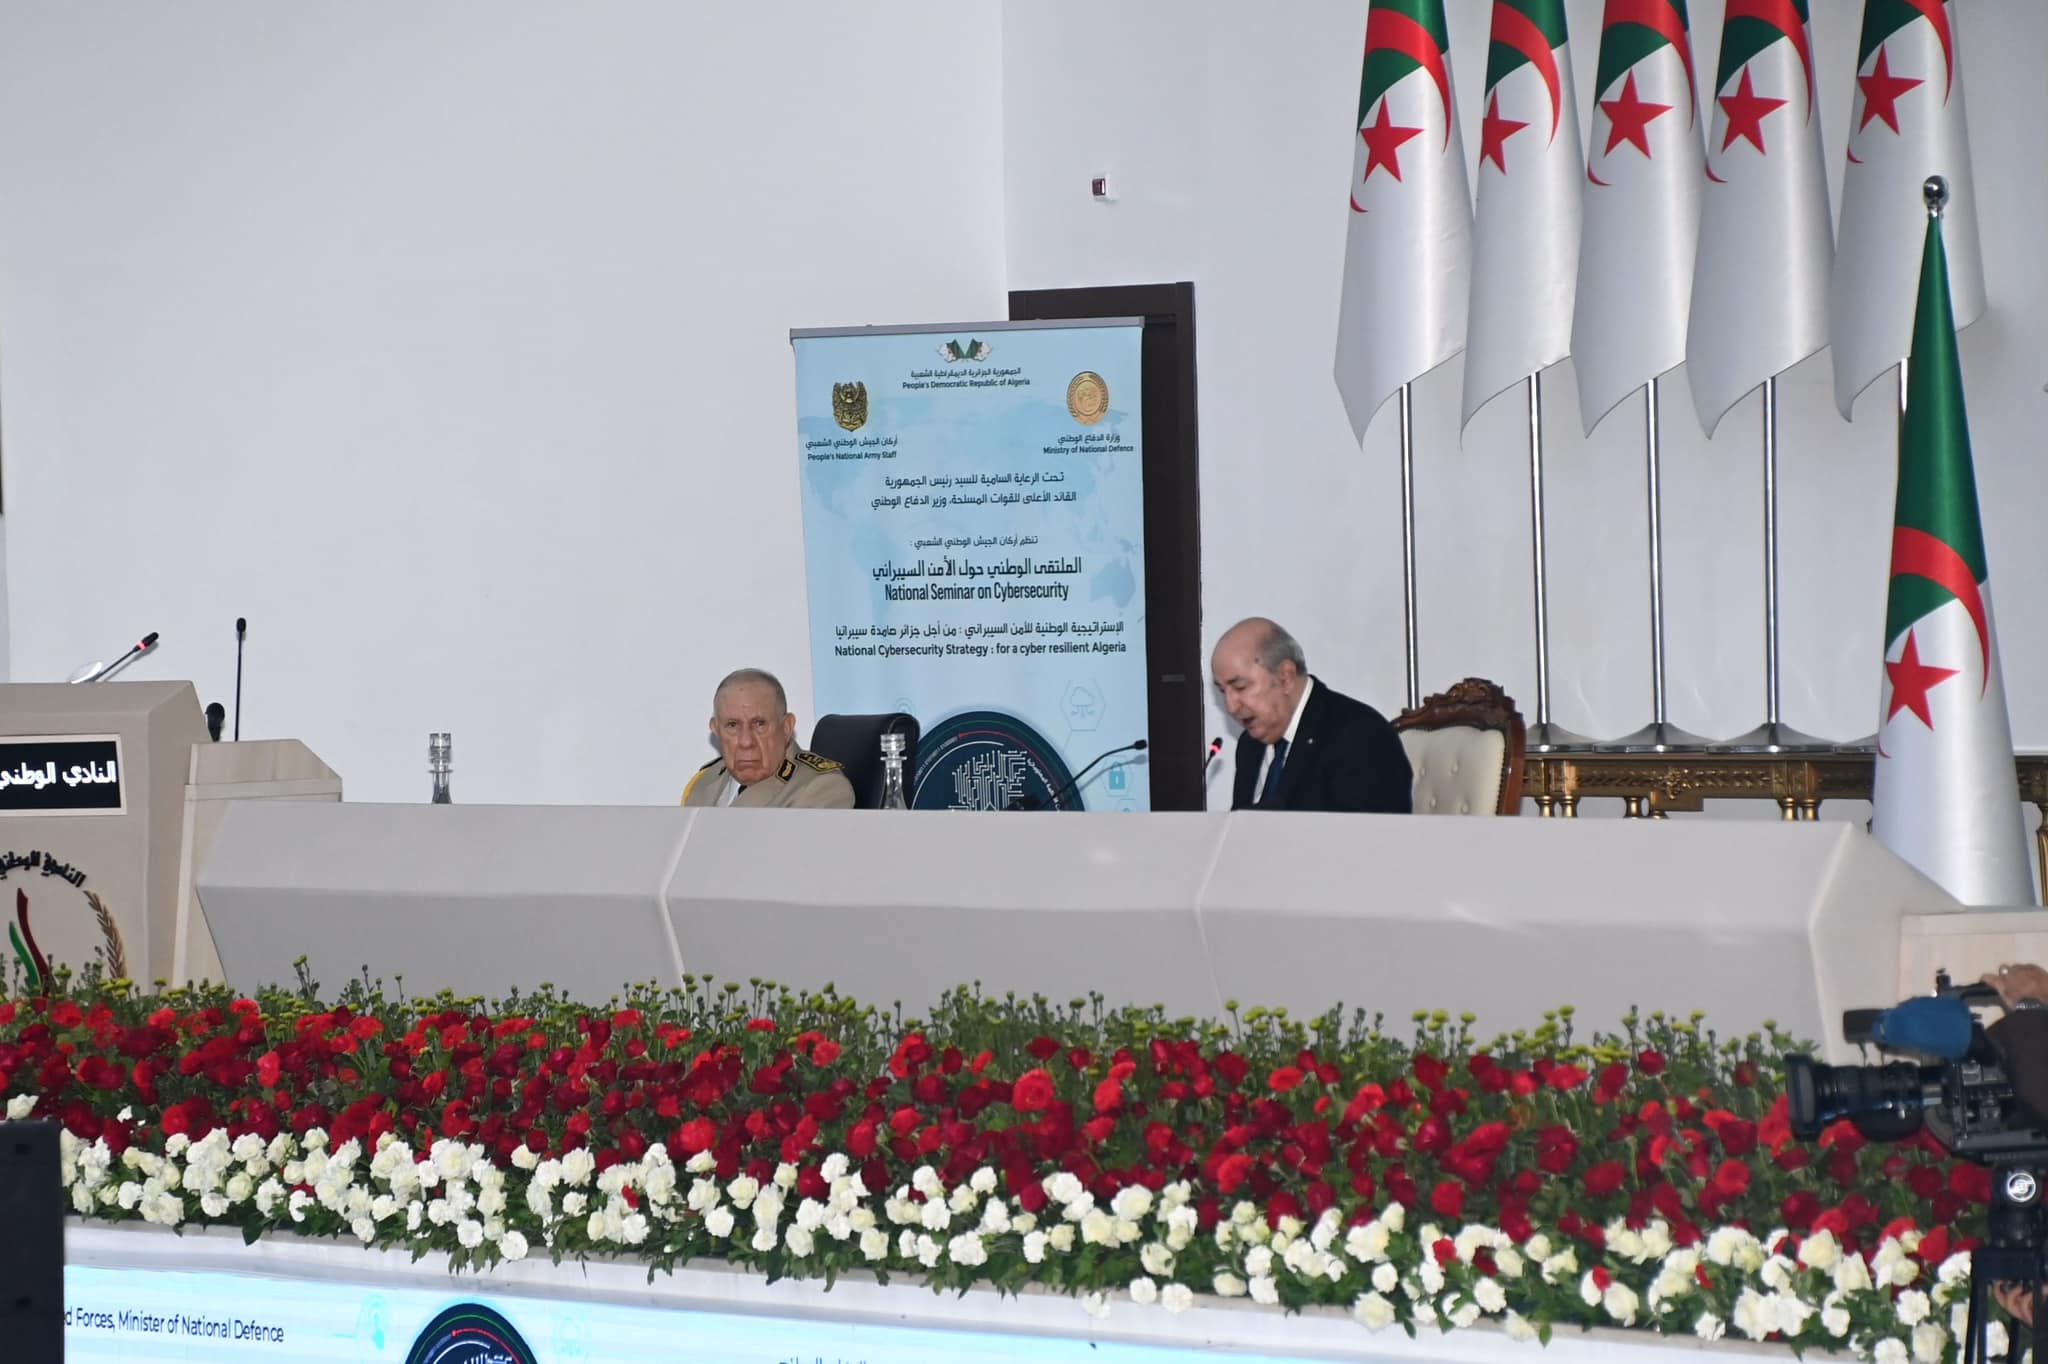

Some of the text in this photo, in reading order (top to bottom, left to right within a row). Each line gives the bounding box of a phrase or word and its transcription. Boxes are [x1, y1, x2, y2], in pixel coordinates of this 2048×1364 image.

[902, 378, 1031, 390] People's Democratic Republic of Algeria
[807, 450, 897, 462] People's National Army Staff
[1043, 446, 1069, 455] Ministry
[1079, 445, 1107, 453] National
[1108, 444, 1134, 453] Defence
[885, 471, 1065, 490] تحت الرعاية السامية للسيد رئيس الجمهورية
[871, 496, 901, 510] الوطني
[904, 495, 929, 509] الدفاع
[931, 496, 947, 508] وزير
[990, 492, 1020, 506] للقوات
[1022, 490, 1052, 504] الأعلى
[1053, 491, 1077, 503] القائد
[914, 536, 943, 550] الشعبي
[944, 536, 971, 549] الوطني
[973, 535, 997, 548] الجيش
[1000, 533, 1018, 547] أركان
[1019, 535, 1038, 546] تنظم
[872, 555, 1082, 582] الملتقى الوطني حول الأمن السيبراني
[885, 580, 1069, 602] National Seminar on Cybersecurity
[835, 625, 868, 640] سيبرانيا
[870, 624, 897, 638] صامدة
[899, 624, 920, 639] جزائر
[923, 620, 941, 638] أجل
[942, 623, 957, 637] من
[964, 622, 1008, 639] السيبراني
[1010, 620, 1033, 635] للأمن
[1035, 621, 1069, 637] الوطنية
[1071, 621, 1124, 636] الإستراتيجية
[835, 644, 876, 656] National
[878, 643, 944, 658] Cybersecurity
[945, 643, 988, 657] Strategy
[996, 642, 1010, 654] for
[1012, 645, 1018, 654] a
[1019, 642, 1047, 656] cyber
[1048, 641, 1090, 654] resilient
[1091, 640, 1127, 655] Algeria
[0, 760, 117, 790] النادي الوطني
[76, 1307, 115, 1333] Forces,
[118, 1309, 164, 1333] Minister
[167, 1314, 180, 1334] of
[182, 1315, 231, 1339] National
[234, 1319, 285, 1343] Defence
